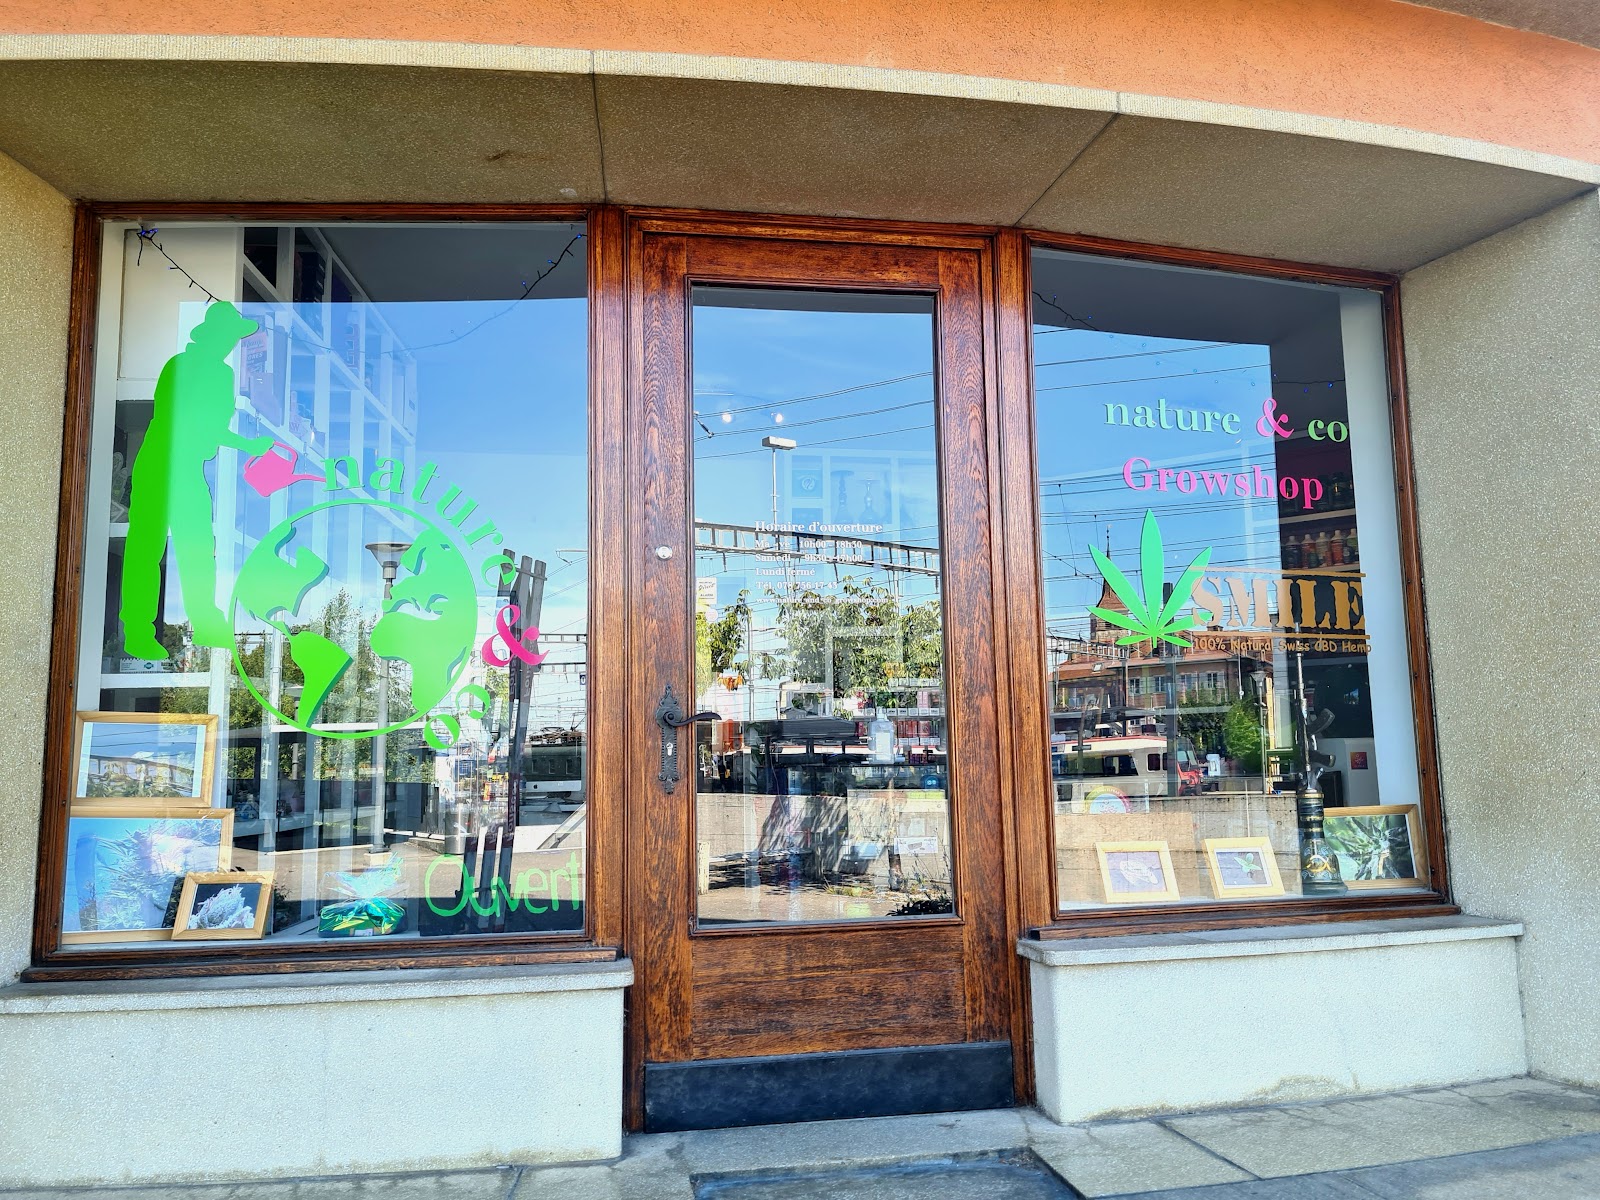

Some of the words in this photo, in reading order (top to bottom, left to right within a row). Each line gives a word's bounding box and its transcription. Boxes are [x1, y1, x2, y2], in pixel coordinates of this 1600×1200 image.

[1104, 398, 1241, 435] nature
[1256, 397, 1294, 438] &
[1307, 418, 1348, 443] co
[1122, 457, 1323, 510] Growshop
[321, 455, 517, 588] nature
[755, 521, 805, 532] Horaire
[809, 521, 883, 533] d'ouverture
[755, 540, 770, 548] Ma
[799, 540, 826, 548] 10h00
[836, 540, 862, 548] 18h30
[755, 553, 791, 562] Samedi
[804, 554, 827, 562] 9h30
[837, 554, 863, 562] 17h00
[756, 568, 785, 576] Lundi
[786, 567, 815, 576] fermé
[815, 581, 824, 590] 17
[1191, 576, 1366, 631] SMILE
[482, 603, 549, 668] &
[1193, 637, 1226, 650] 100%
[1231, 639, 1273, 651] Natural
[1278, 639, 1310, 652] Swiss
[1315, 640, 1337, 652] CBD
[1342, 641, 1372, 655] Hemp
[424, 684, 492, 750] co
[424, 853, 581, 918] Ouvert
